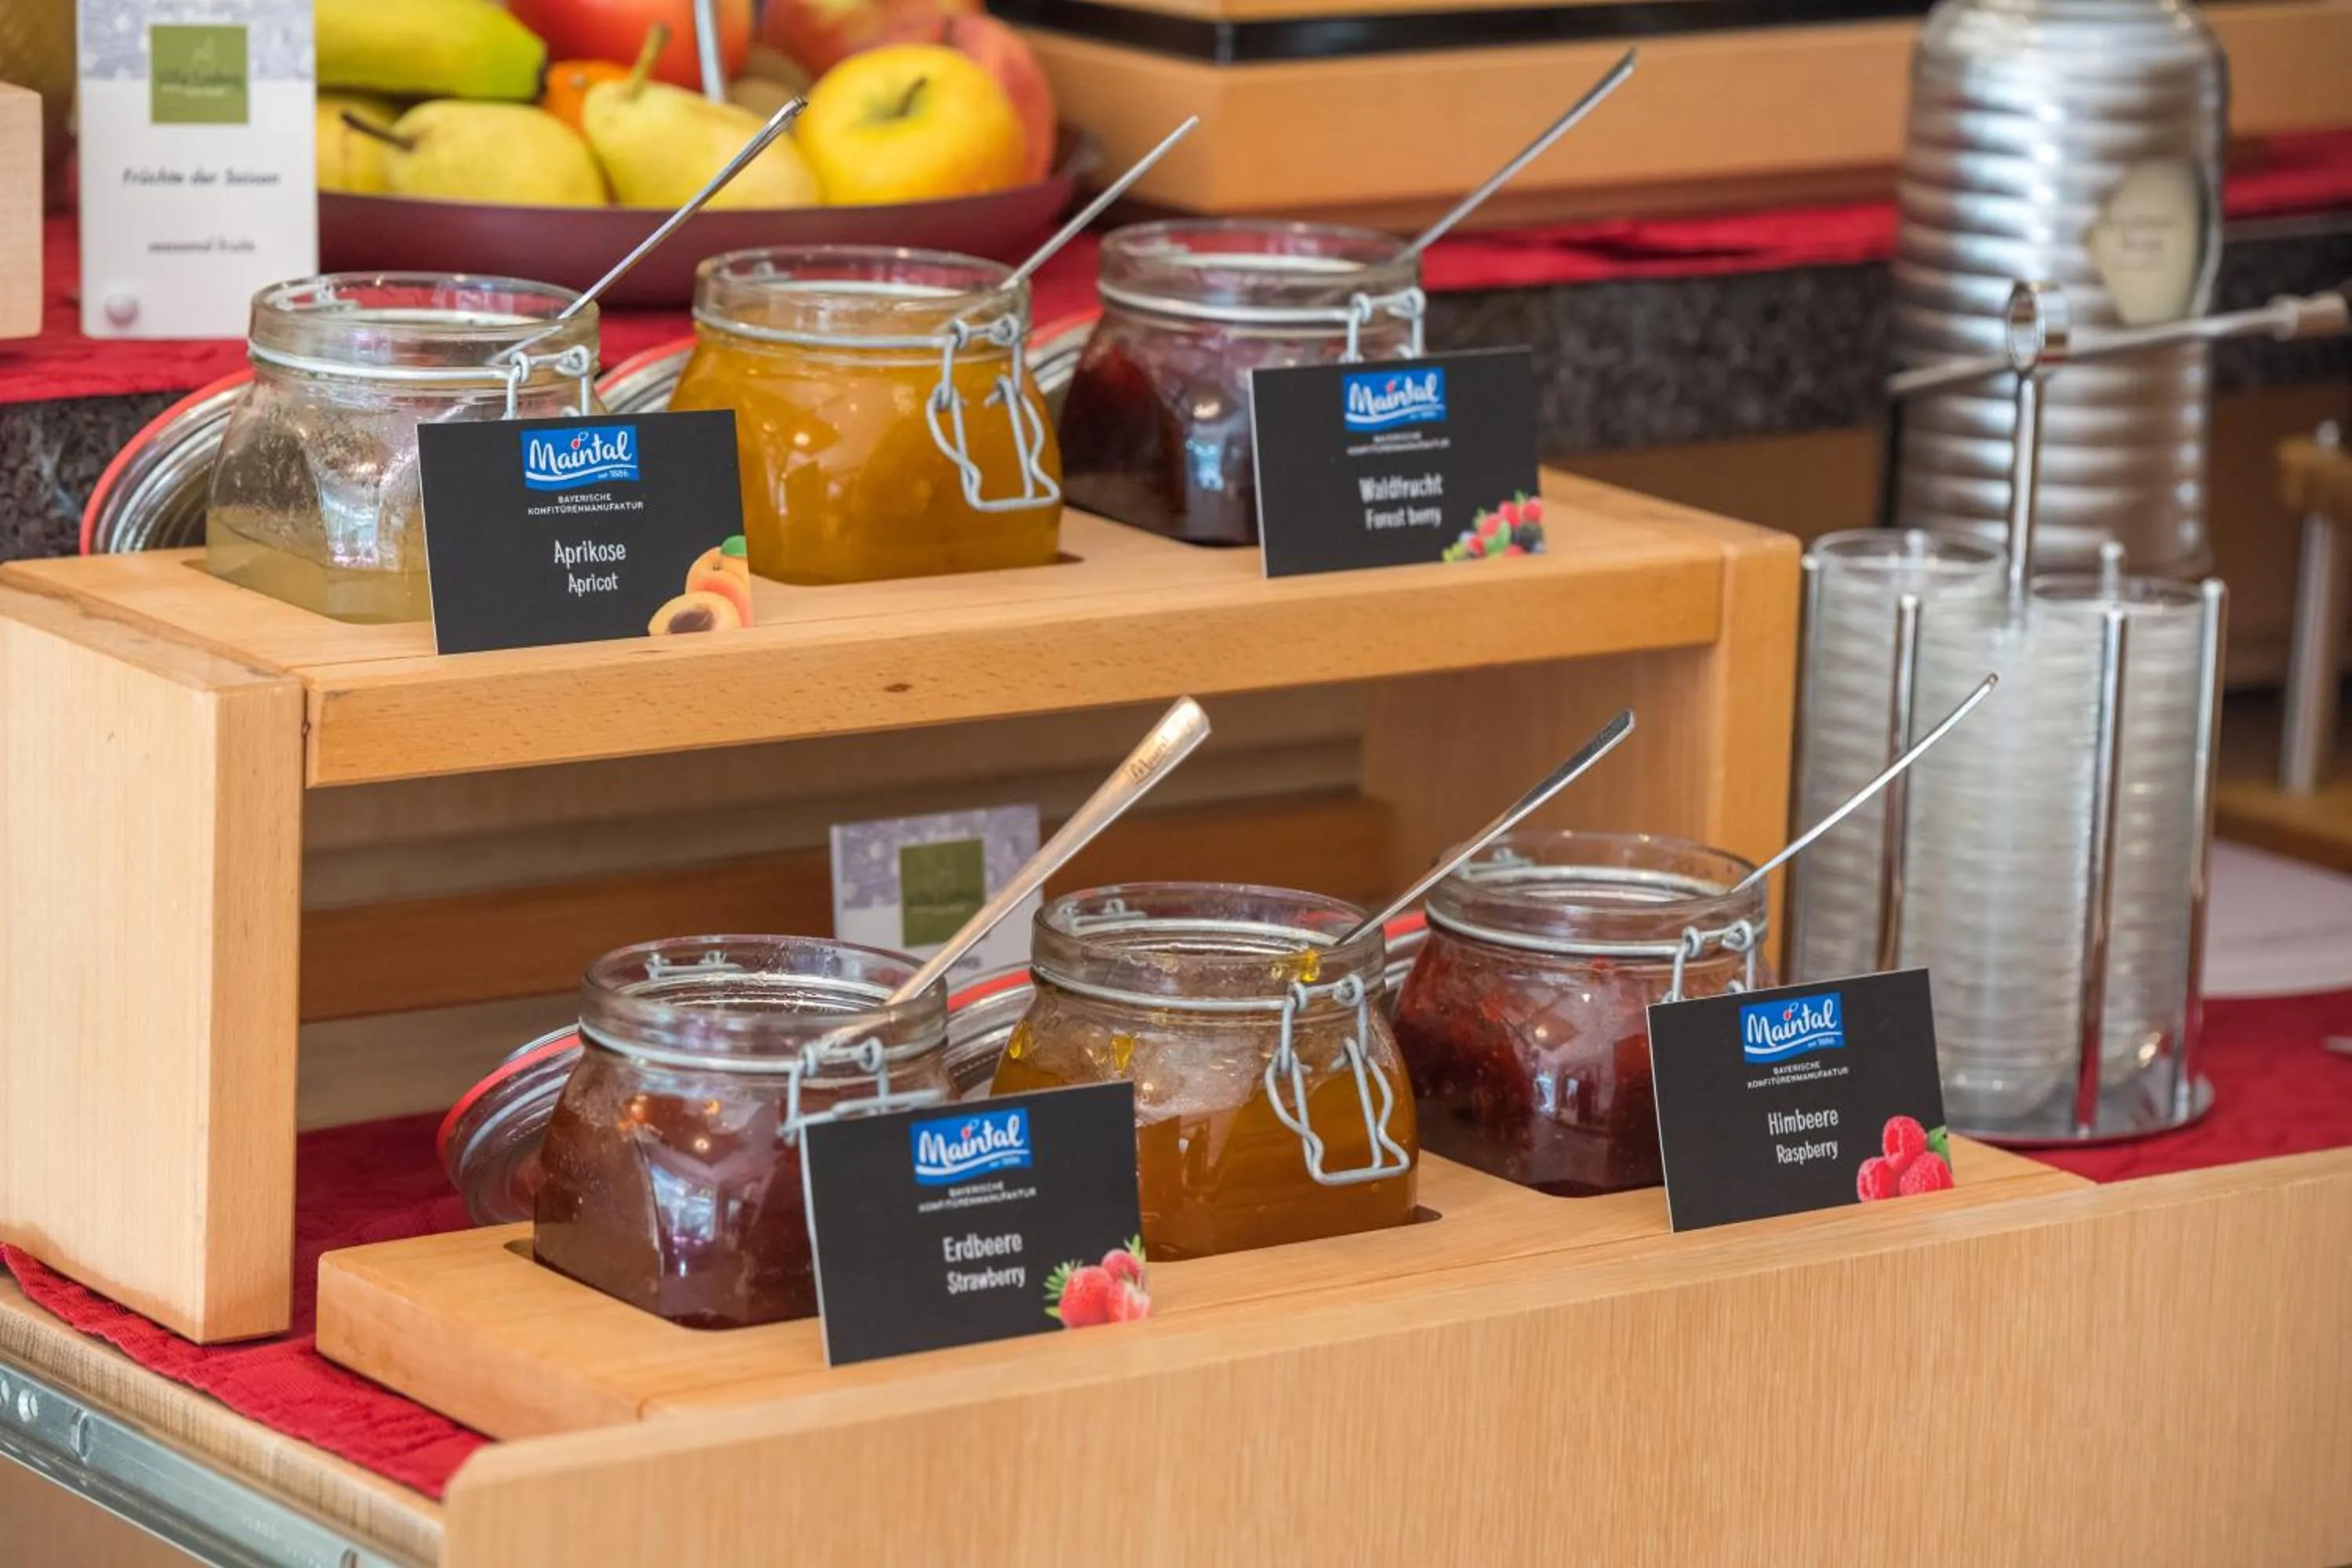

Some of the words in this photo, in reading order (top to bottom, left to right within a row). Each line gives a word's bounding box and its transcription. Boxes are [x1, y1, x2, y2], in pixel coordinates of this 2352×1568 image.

[1348, 372, 1440, 416] Maintal
[528, 430, 633, 476] Maintal
[557, 492, 612, 504] BAYERISCHE
[1358, 471, 1443, 503] Waldfrucht
[528, 501, 644, 516] KONFITÜRENMANUFAKTUR
[1365, 507, 1406, 531] Forest
[1406, 505, 1443, 529] berry
[554, 539, 626, 569] Aprikose
[568, 572, 619, 597] Apricot
[1747, 998, 1838, 1047] Maintal
[1773, 1061, 1820, 1075] BAYERISCHE
[1768, 1108, 1839, 1136] Himbeere
[919, 1114, 1025, 1167] Maintal
[1776, 1140, 1838, 1166] Raspberry
[942, 1232, 1023, 1262] Erdbeere
[946, 1265, 1025, 1295] Strawberry
